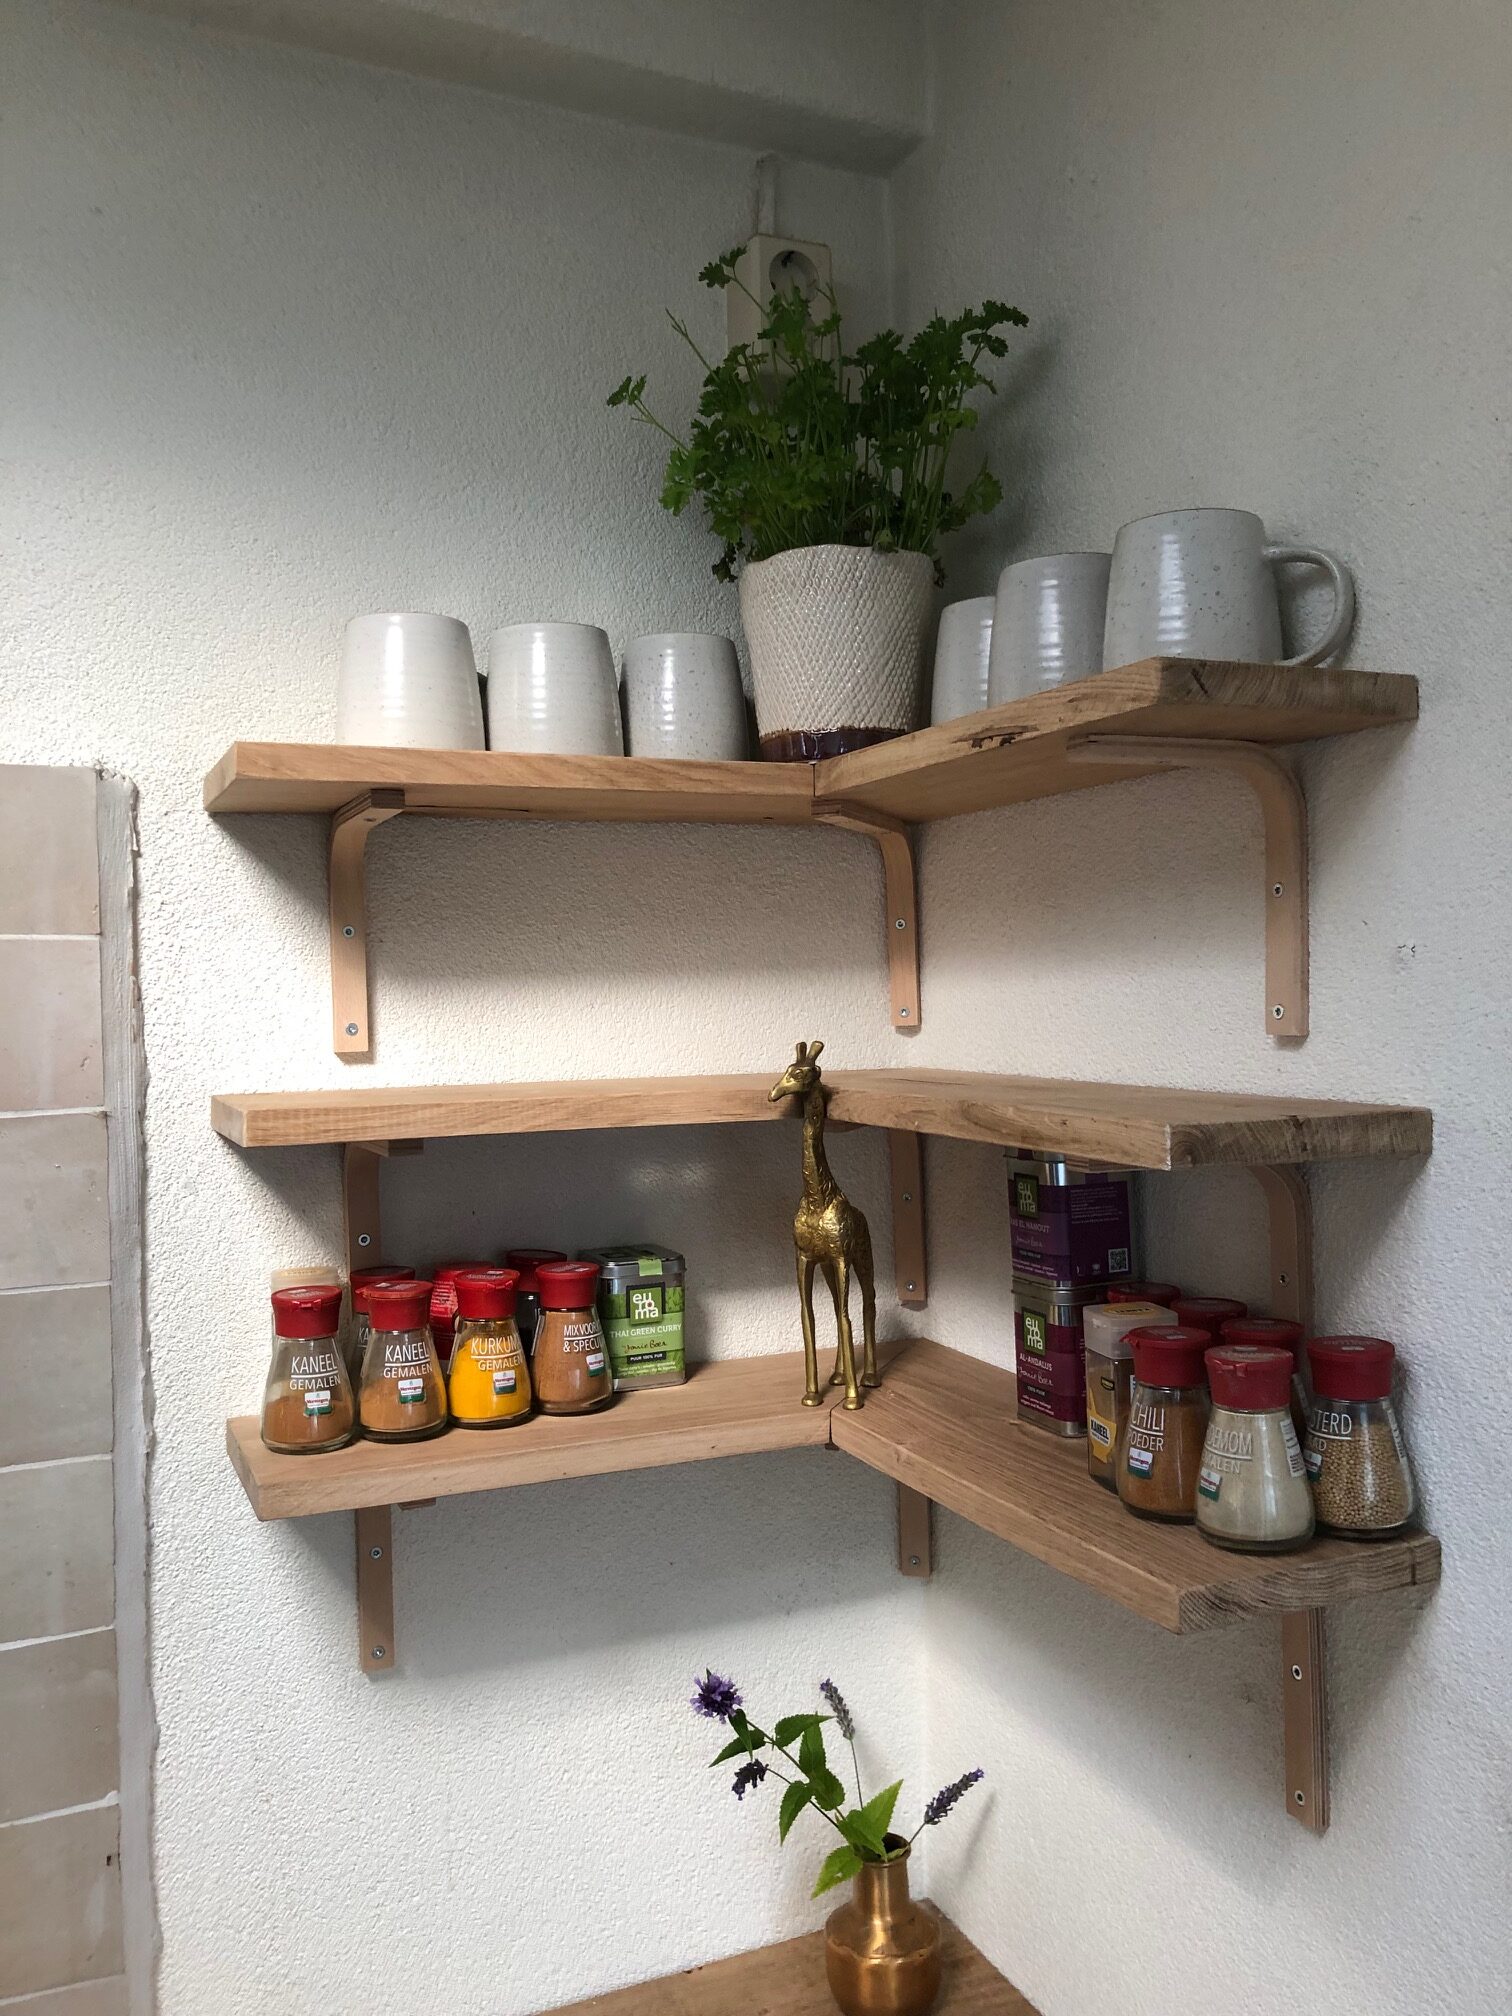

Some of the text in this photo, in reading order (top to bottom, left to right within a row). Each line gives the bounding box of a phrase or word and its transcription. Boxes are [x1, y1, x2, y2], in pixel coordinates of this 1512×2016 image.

[563, 1324, 580, 1337] MIX
[611, 1323, 682, 1338] THAI GREEN CURRY
[385, 1341, 430, 1362] KANEEL
[563, 1340, 571, 1353] &
[291, 1352, 338, 1374] KANEEL
[383, 1362, 433, 1379] GEMALEN
[478, 1354, 523, 1371] GEMALEN
[289, 1374, 341, 1391] GEMALEN
[1131, 1402, 1165, 1431] CHILI
